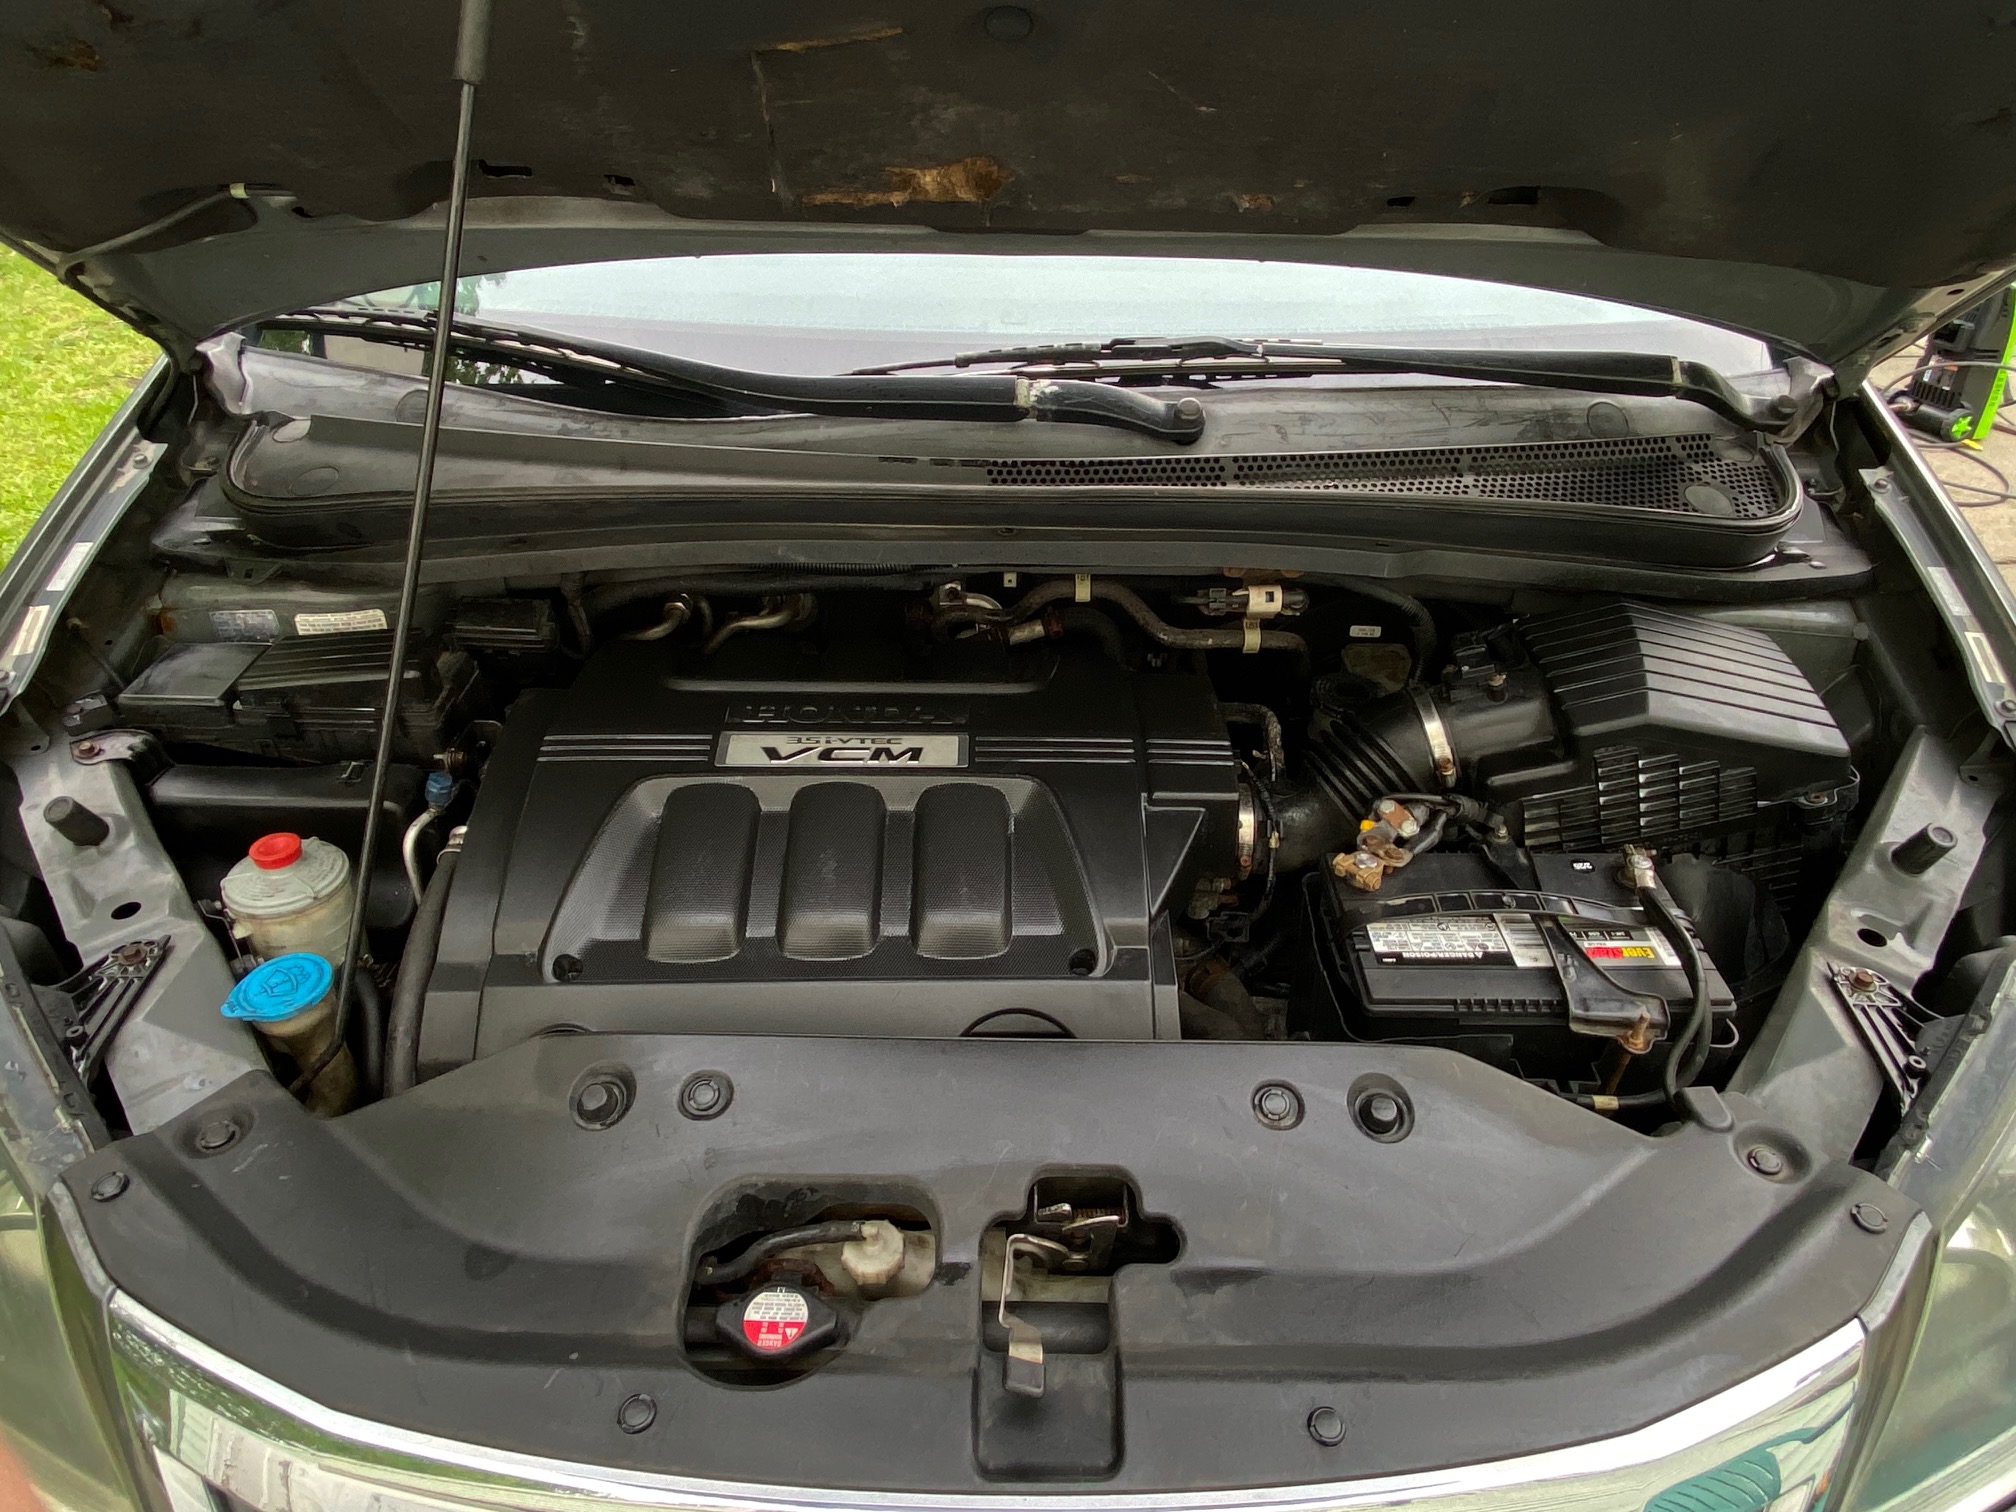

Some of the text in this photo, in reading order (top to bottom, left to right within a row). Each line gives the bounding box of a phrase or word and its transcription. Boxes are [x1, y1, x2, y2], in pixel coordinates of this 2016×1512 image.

[742, 705, 952, 725] HONDA
[825, 736, 903, 745] i-VTEC
[760, 746, 925, 764] VCM
[1586, 947, 1655, 959] EverStart
